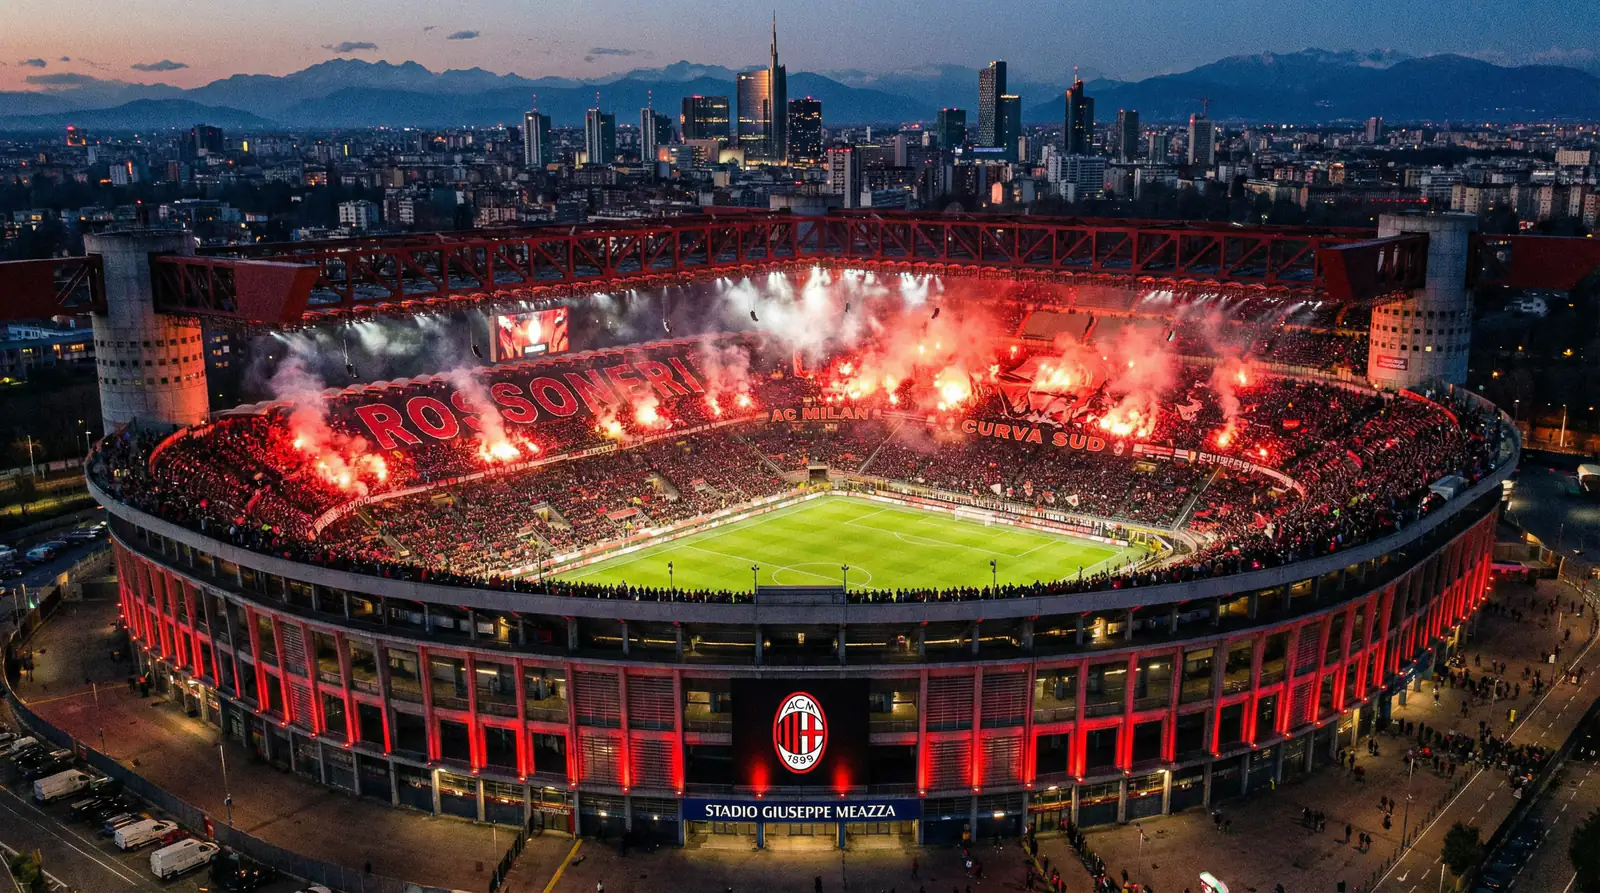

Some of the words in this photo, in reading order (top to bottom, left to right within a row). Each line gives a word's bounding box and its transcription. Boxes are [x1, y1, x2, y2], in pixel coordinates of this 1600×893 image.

[355, 356, 705, 450] ROSSONERI
[771, 408, 797, 422] AC
[801, 406, 869, 421] MILAN
[961, 419, 1043, 444] CURVA
[1051, 431, 1106, 452] SUD
[784, 698, 816, 714] ACM
[787, 754, 814, 765] 1899
[704, 803, 758, 818] STADIO
[762, 804, 832, 819] GIUSEPPE
[835, 804, 896, 818] MEAZZA
